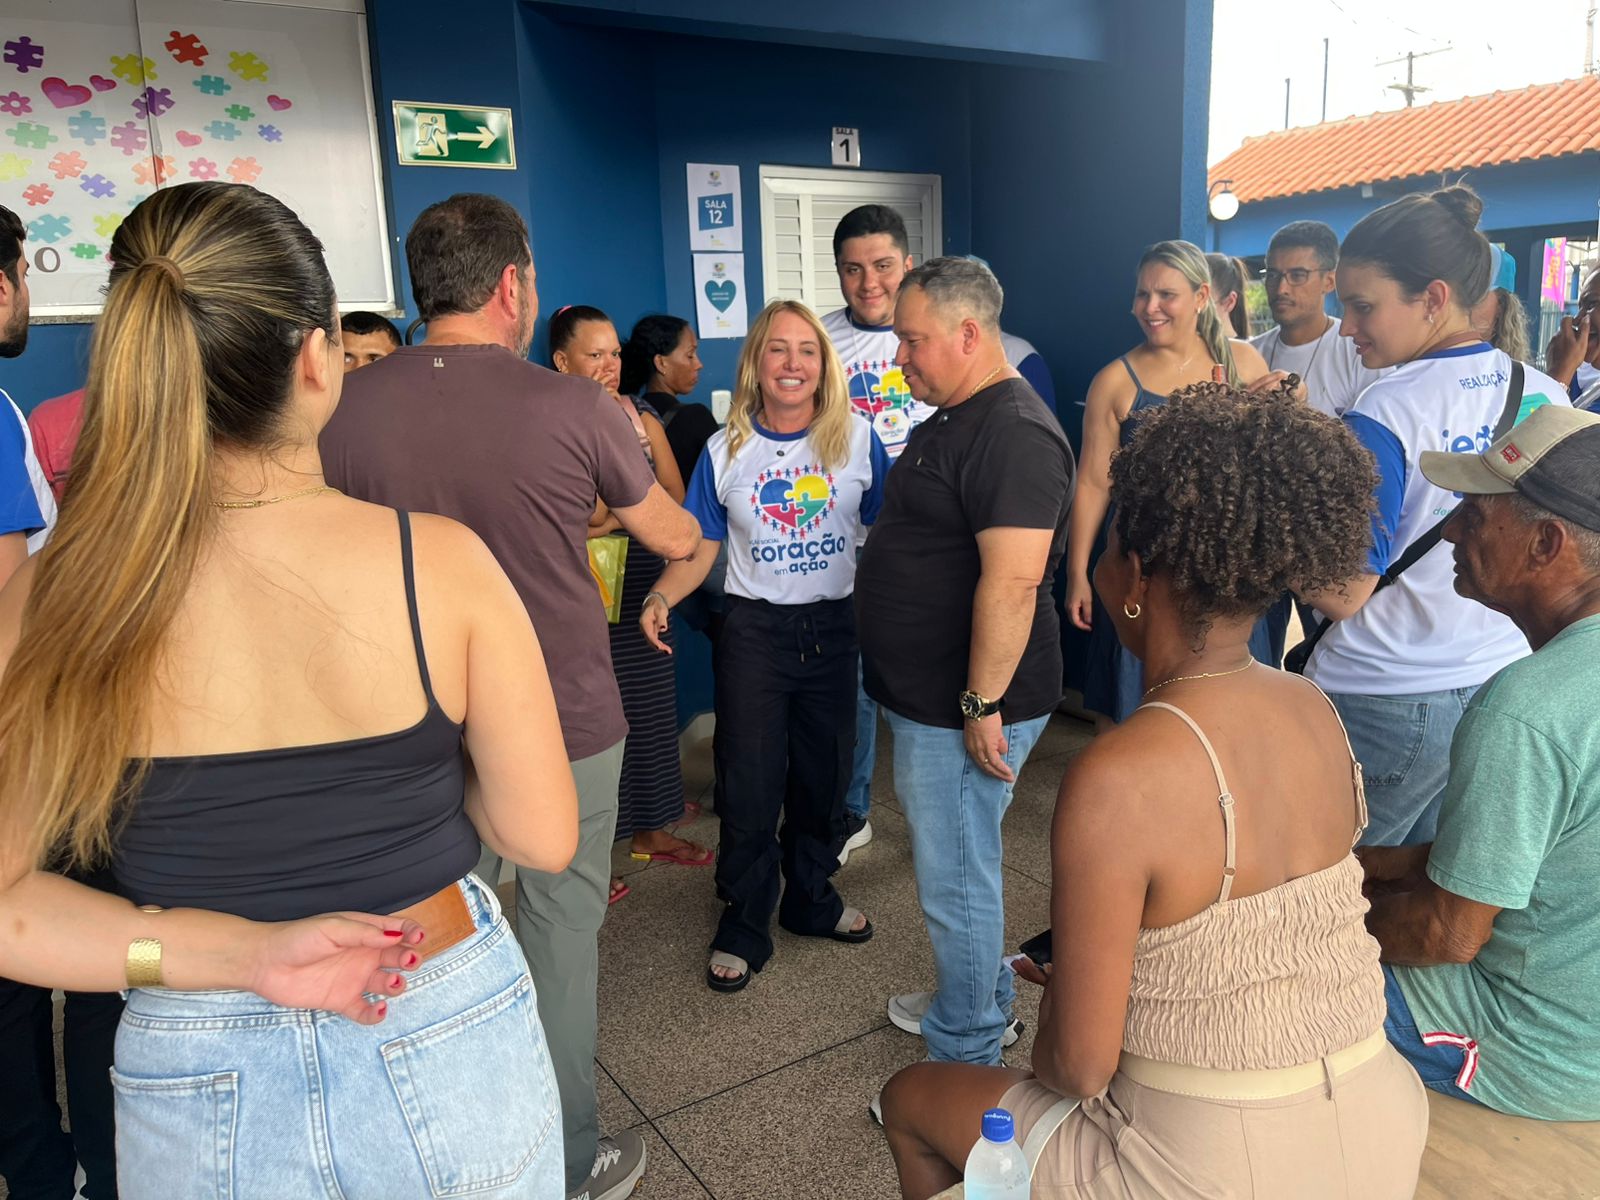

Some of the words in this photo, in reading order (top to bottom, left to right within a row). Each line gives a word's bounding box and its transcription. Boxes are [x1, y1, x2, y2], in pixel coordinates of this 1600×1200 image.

[839, 139, 850, 162] 1
[704, 200, 727, 208] SALA
[708, 209, 723, 224] 12
[751, 533, 846, 563] coração
[774, 567, 789, 576] em
[789, 560, 828, 575] ação
